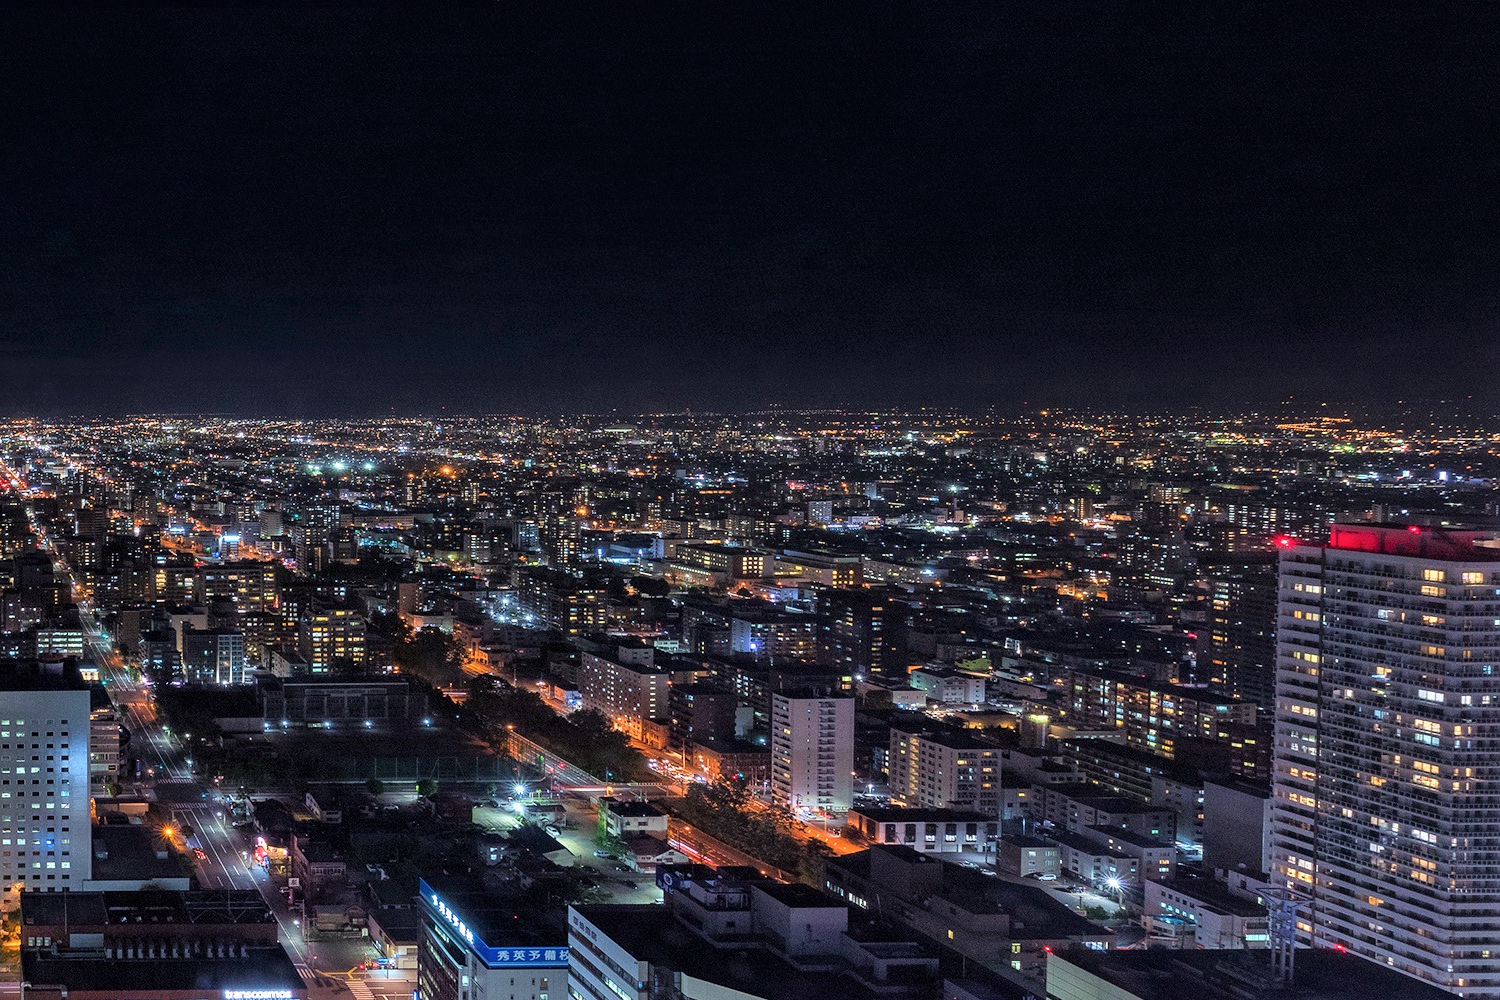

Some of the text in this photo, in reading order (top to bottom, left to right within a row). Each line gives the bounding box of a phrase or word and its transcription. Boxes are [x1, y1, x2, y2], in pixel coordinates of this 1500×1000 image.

[497, 950, 568, 961] 秀英予備校
[225, 990, 292, 999] transcosmos
